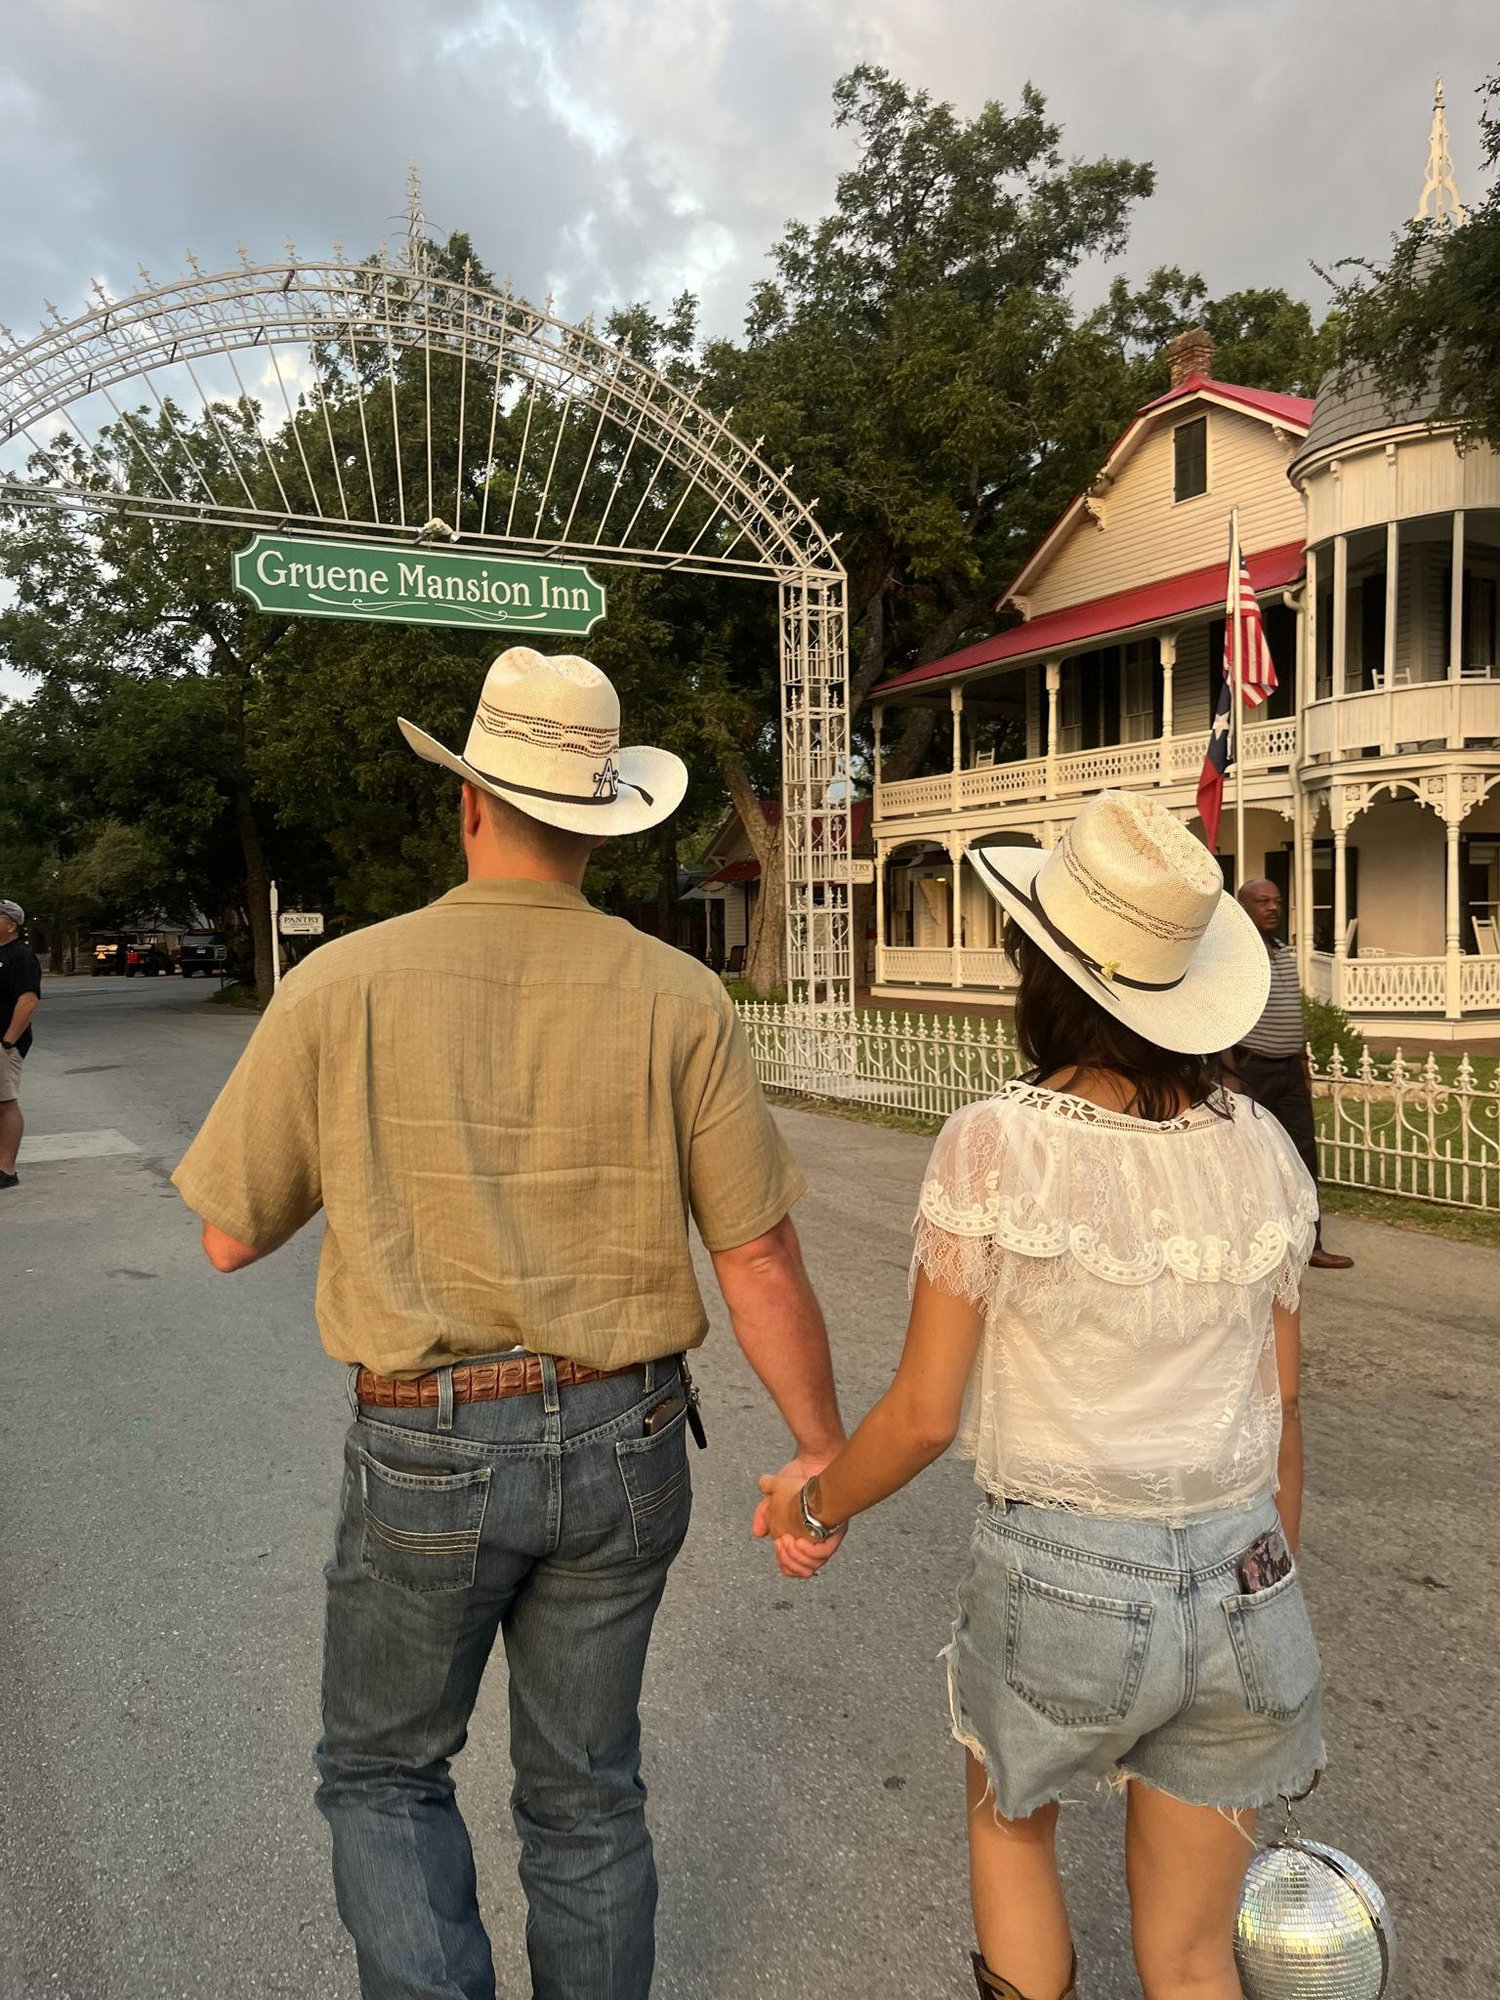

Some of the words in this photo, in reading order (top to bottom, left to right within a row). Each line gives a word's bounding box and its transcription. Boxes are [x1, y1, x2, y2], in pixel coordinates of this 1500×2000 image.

[256, 551, 390, 595] Gruene
[398, 562, 532, 607] Mansion
[539, 576, 591, 612] Inn
[283, 916, 320, 924] PANTRY
